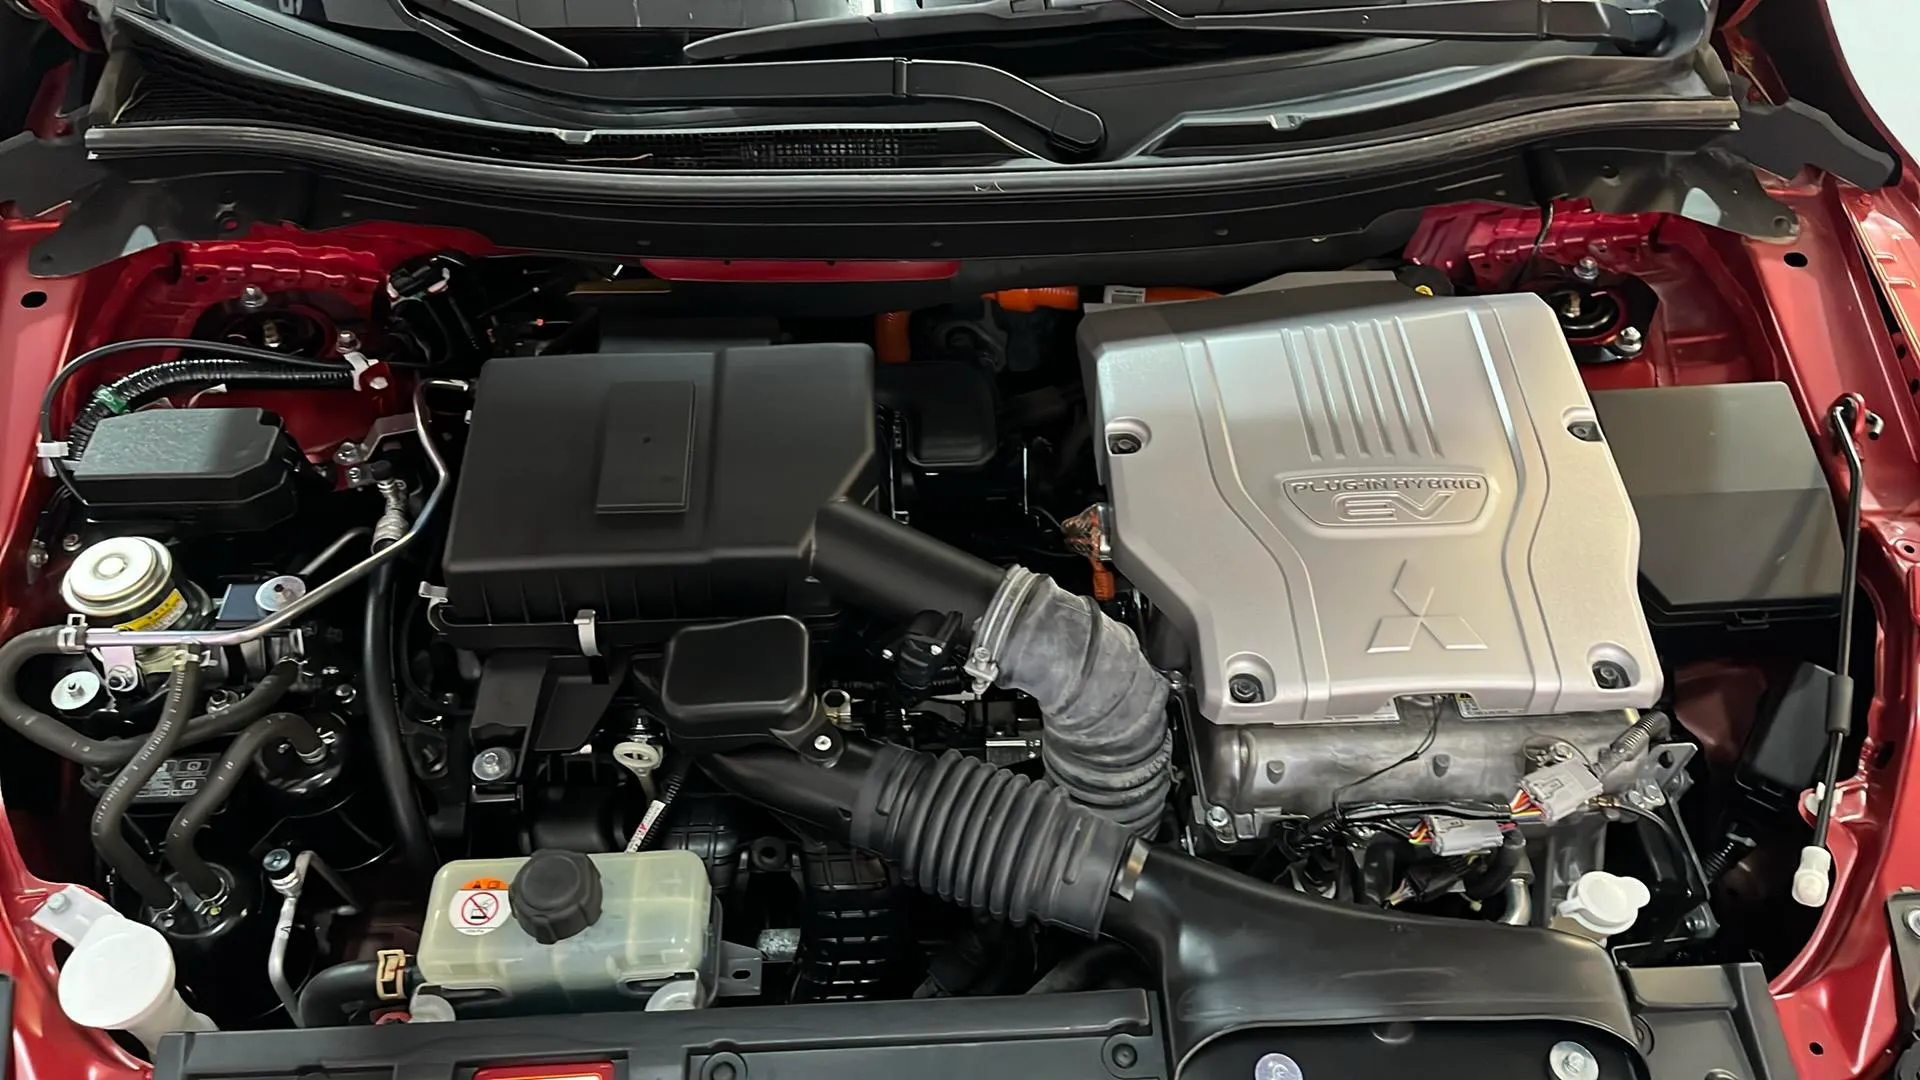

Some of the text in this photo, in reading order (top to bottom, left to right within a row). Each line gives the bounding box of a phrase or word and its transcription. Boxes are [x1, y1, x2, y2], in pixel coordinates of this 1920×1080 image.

[1291, 477, 1481, 493] PLUG-IN HYBRID
[1331, 491, 1457, 521] EV
